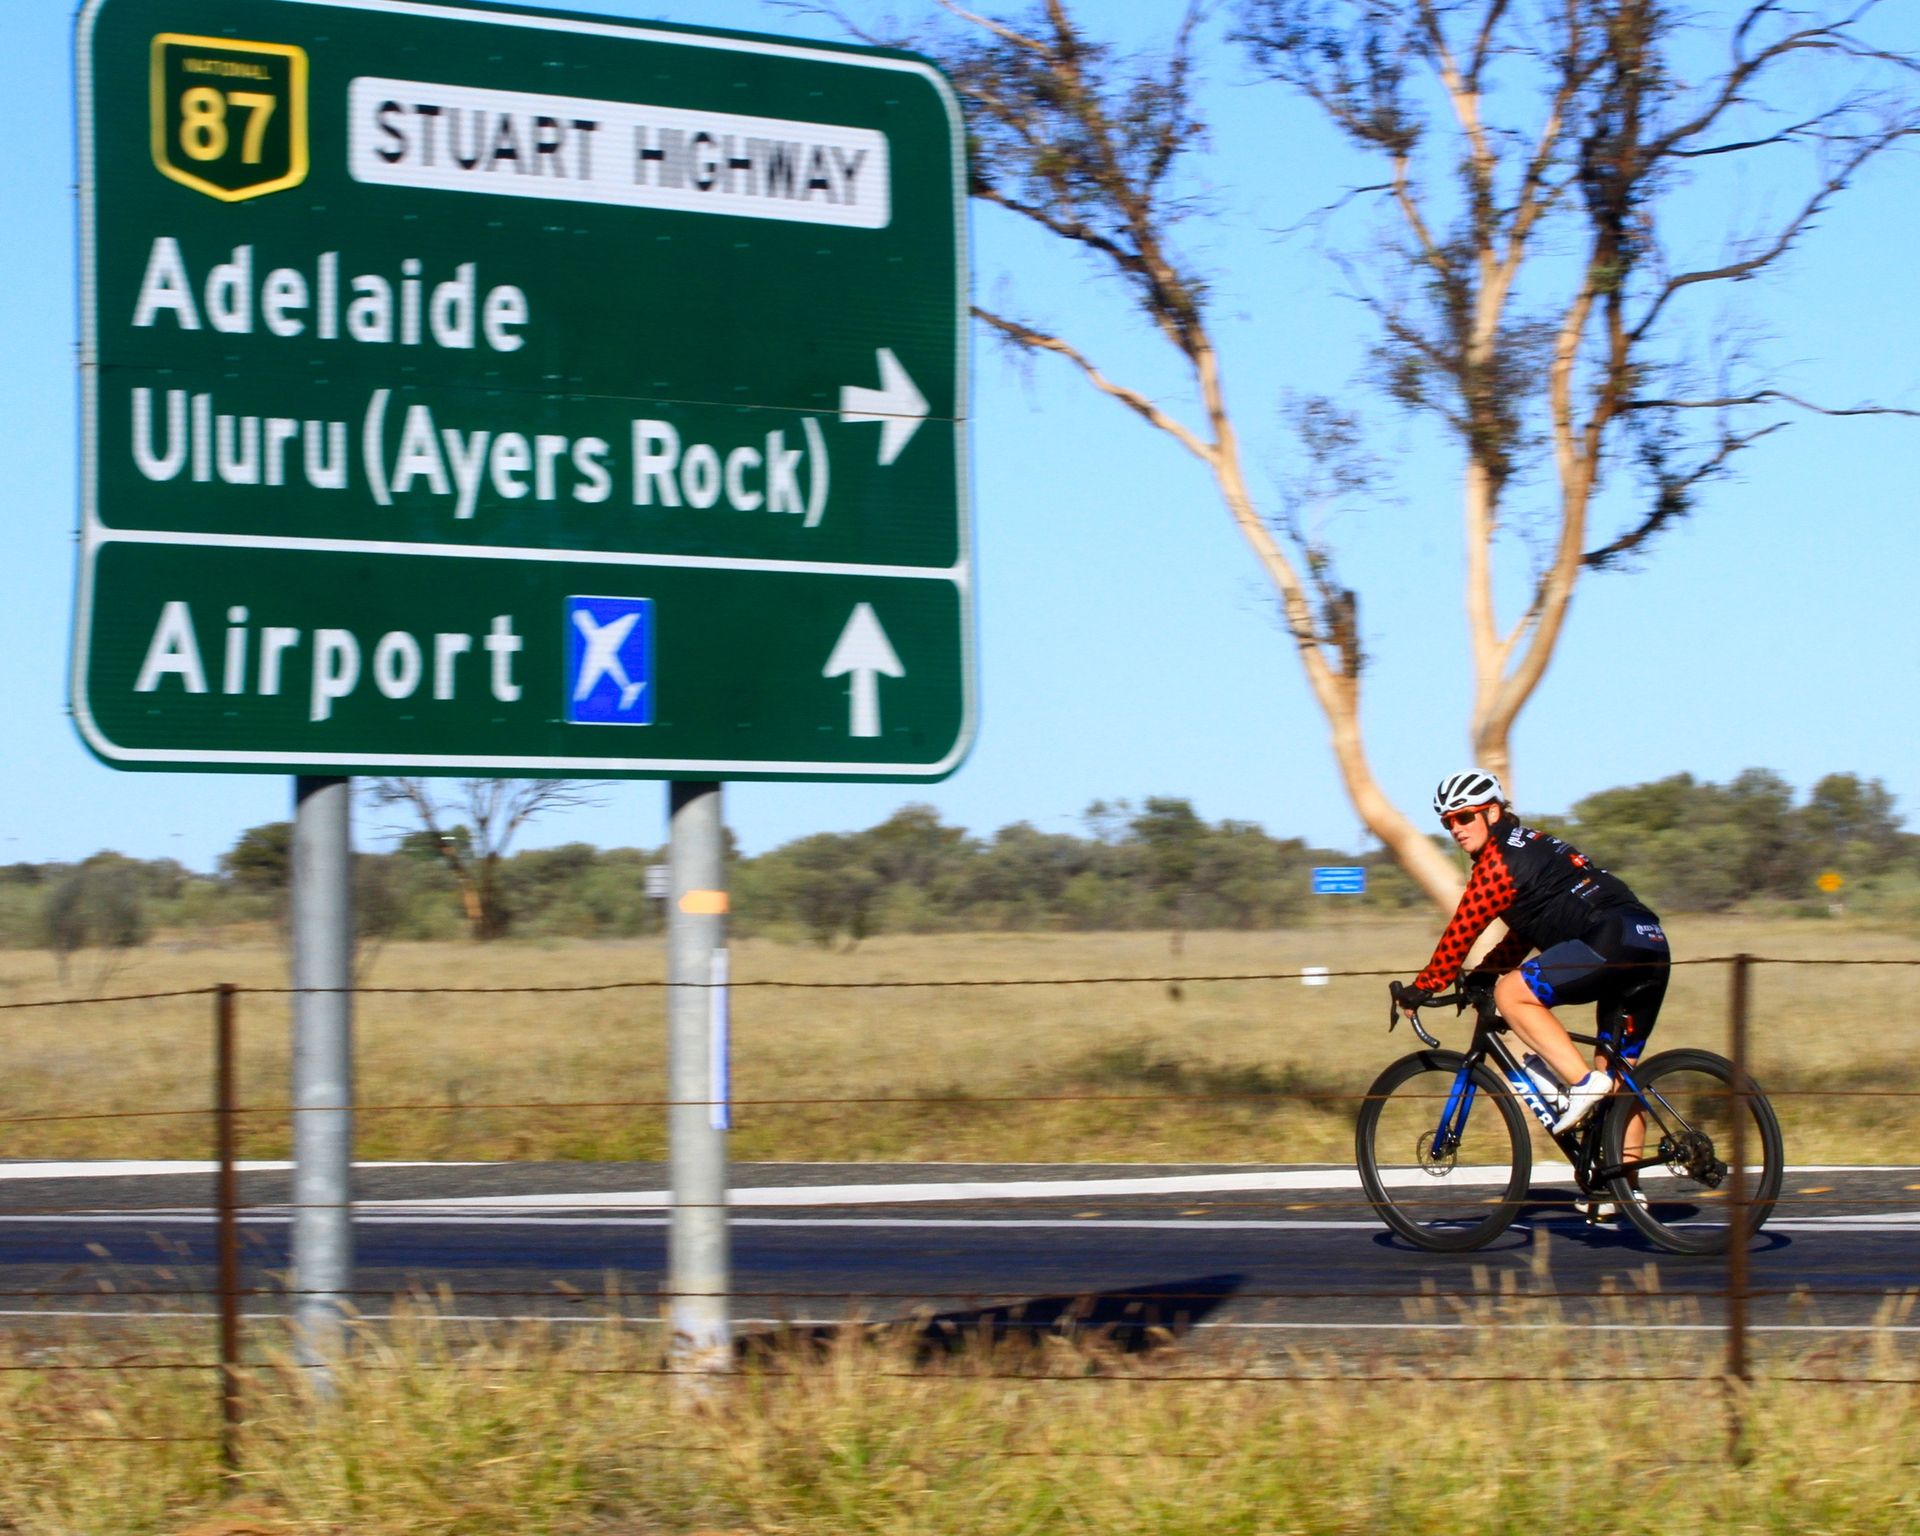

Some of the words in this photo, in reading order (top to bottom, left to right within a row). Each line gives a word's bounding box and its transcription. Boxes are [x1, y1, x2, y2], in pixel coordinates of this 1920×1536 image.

[182, 58, 272, 80] NATIONAL
[180, 86, 277, 164] 87
[375, 99, 599, 181] STUART
[633, 125, 868, 206] HIGHWAY
[131, 236, 529, 352] Adelaide
[131, 387, 349, 489] Uluru
[362, 388, 612, 519] (Ayers
[631, 417, 830, 527] Rock)
[133, 601, 523, 722] Airport
